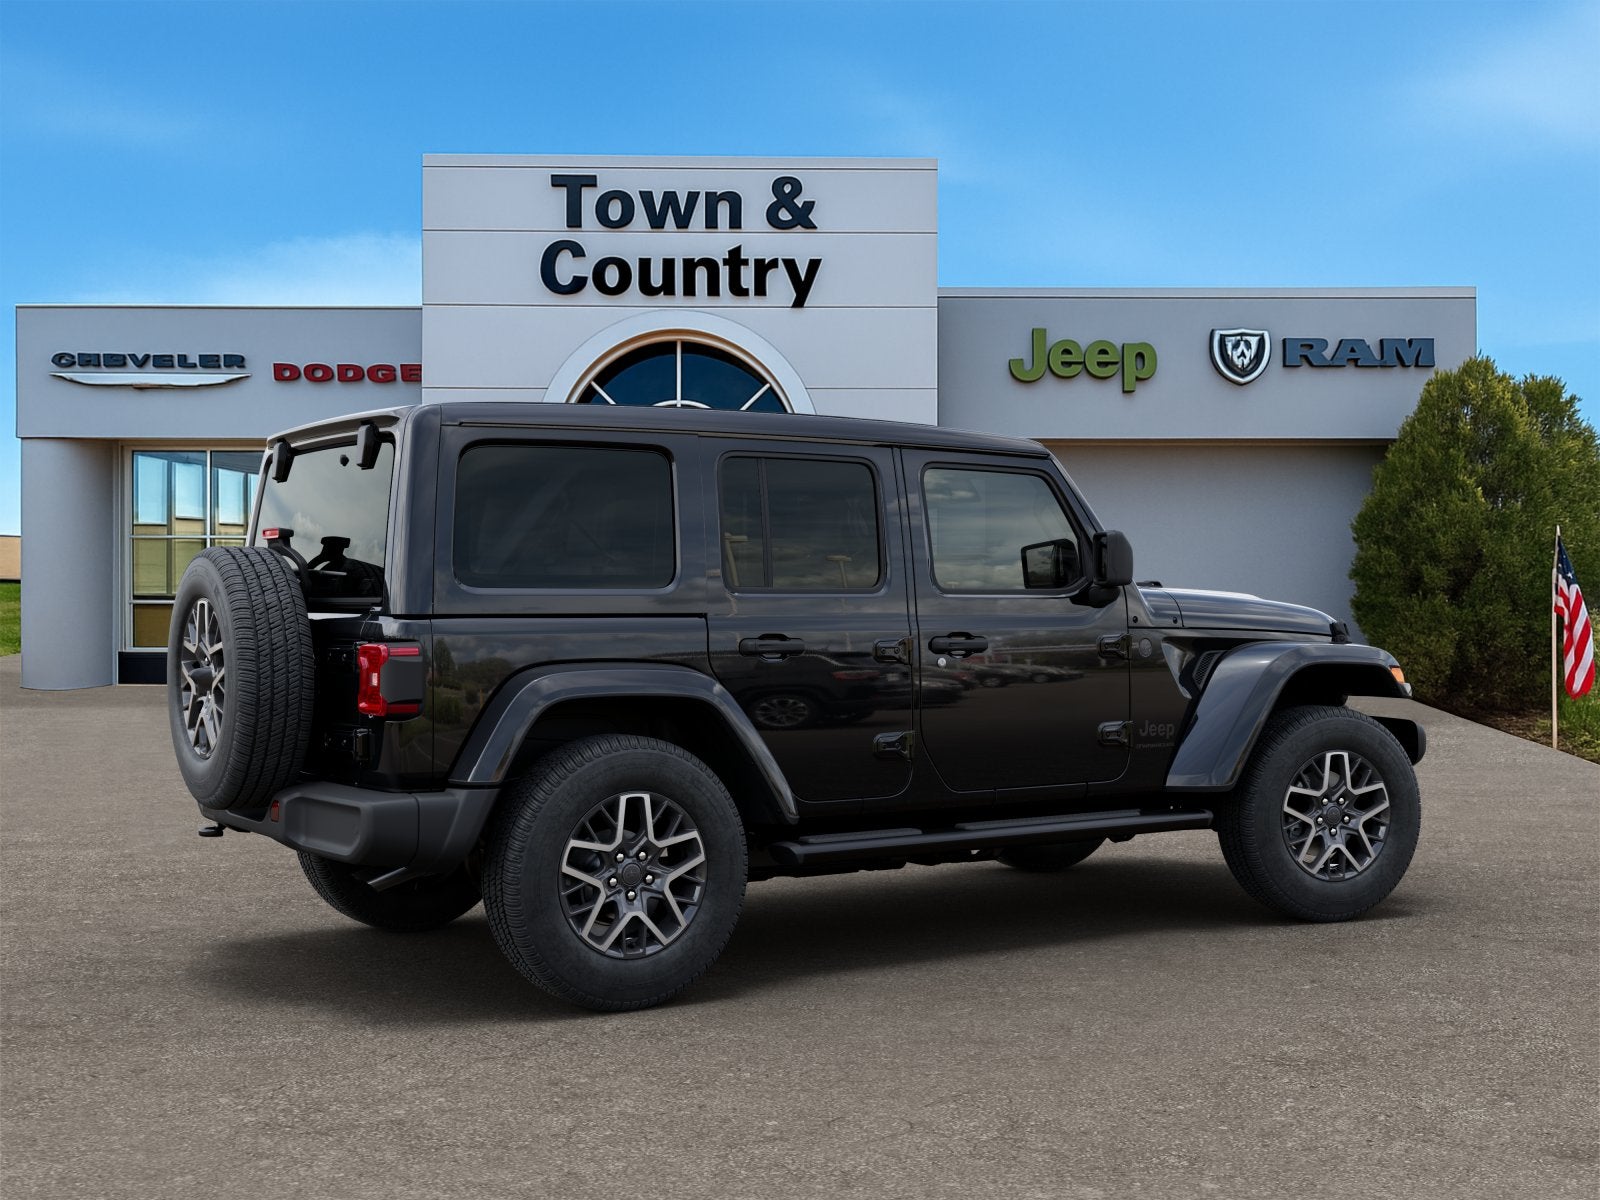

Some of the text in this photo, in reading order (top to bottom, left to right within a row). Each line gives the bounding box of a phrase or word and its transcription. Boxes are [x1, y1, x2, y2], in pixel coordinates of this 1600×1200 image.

[551, 174, 818, 230] Town &
[540, 240, 822, 308] Country
[273, 362, 422, 382] DODGE
[1009, 328, 1157, 393] Jeep
[1282, 337, 1435, 368] RAM
[1139, 720, 1175, 739] Jeep
